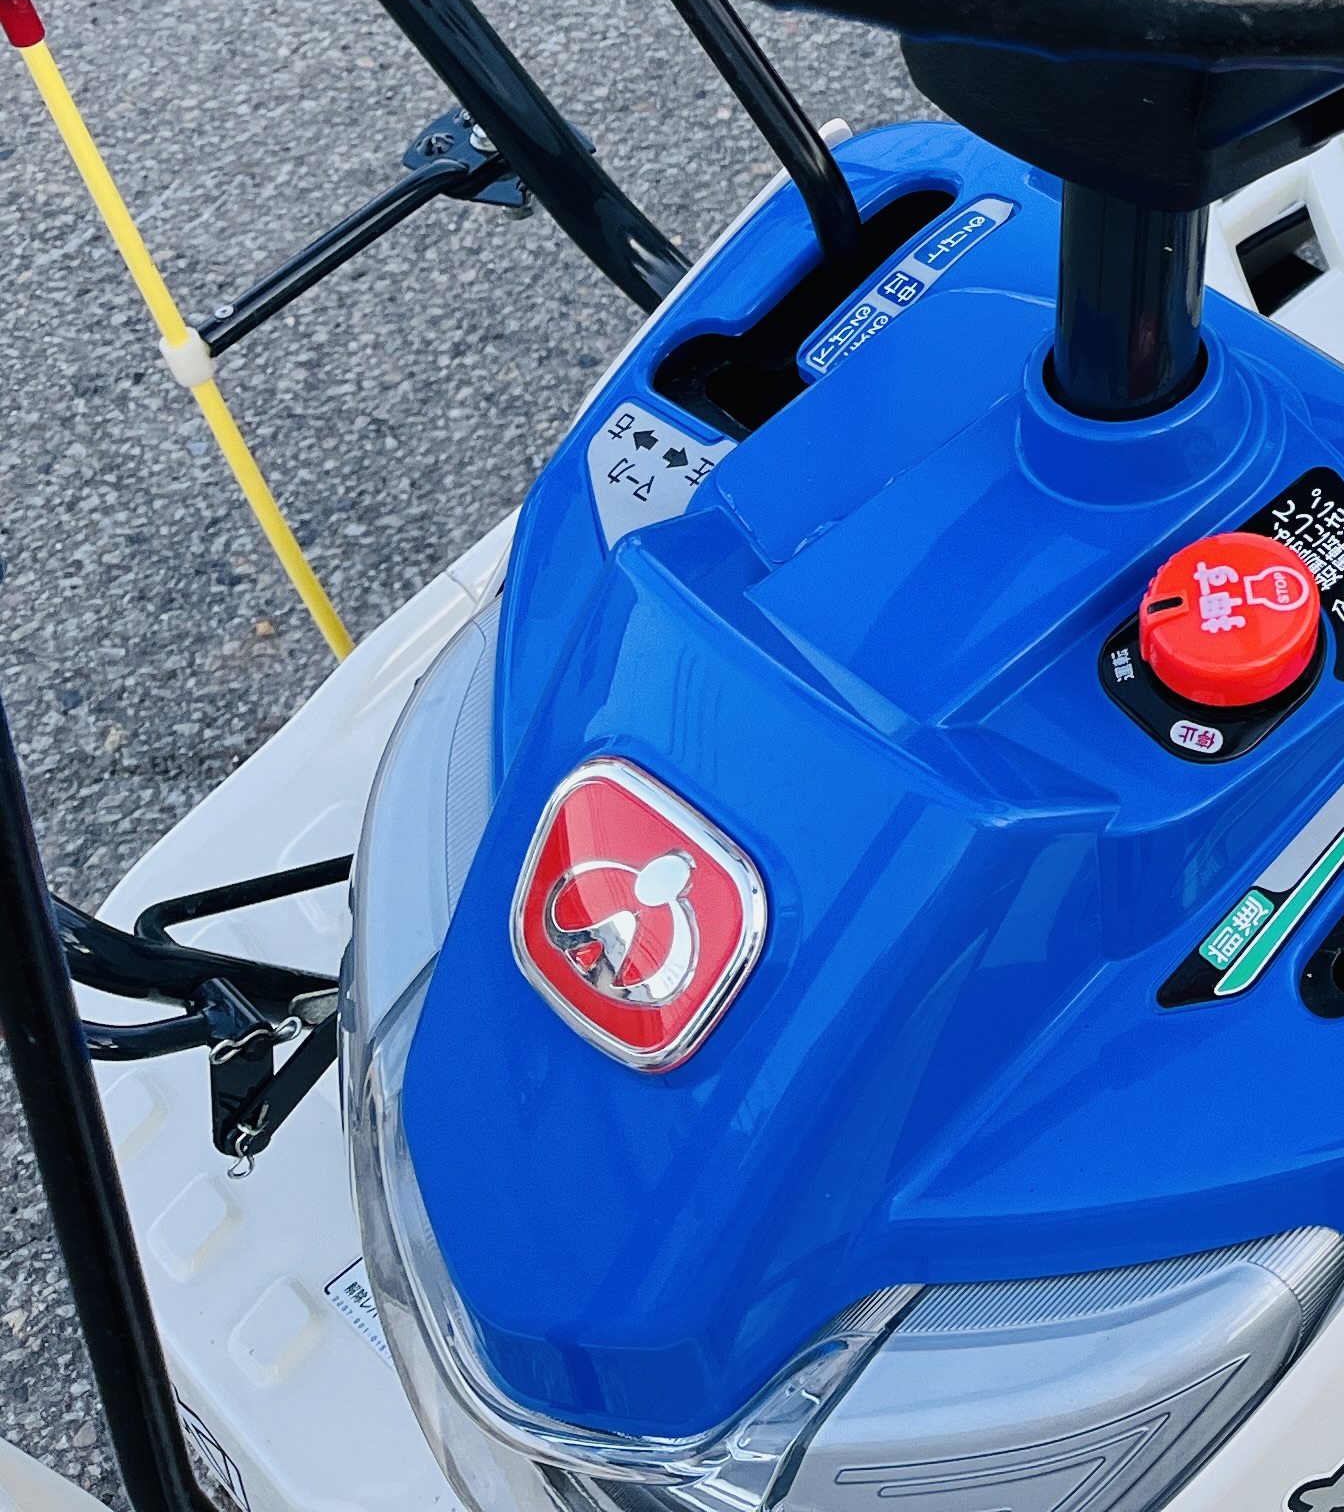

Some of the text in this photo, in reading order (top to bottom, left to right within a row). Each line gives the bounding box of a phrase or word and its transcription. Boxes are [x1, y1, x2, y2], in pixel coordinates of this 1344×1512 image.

[926, 214, 987, 265] 上げる
[882, 271, 918, 305] 中立
[812, 304, 873, 368] 下げる
[607, 412, 637, 441] 右
[607, 457, 657, 502] マーカ
[685, 456, 717, 487] 左
[1192, 561, 1247, 635] 押す
[1273, 570, 1292, 605] STOP
[1178, 724, 1217, 750] 停止
[1206, 895, 1270, 963] 前進
